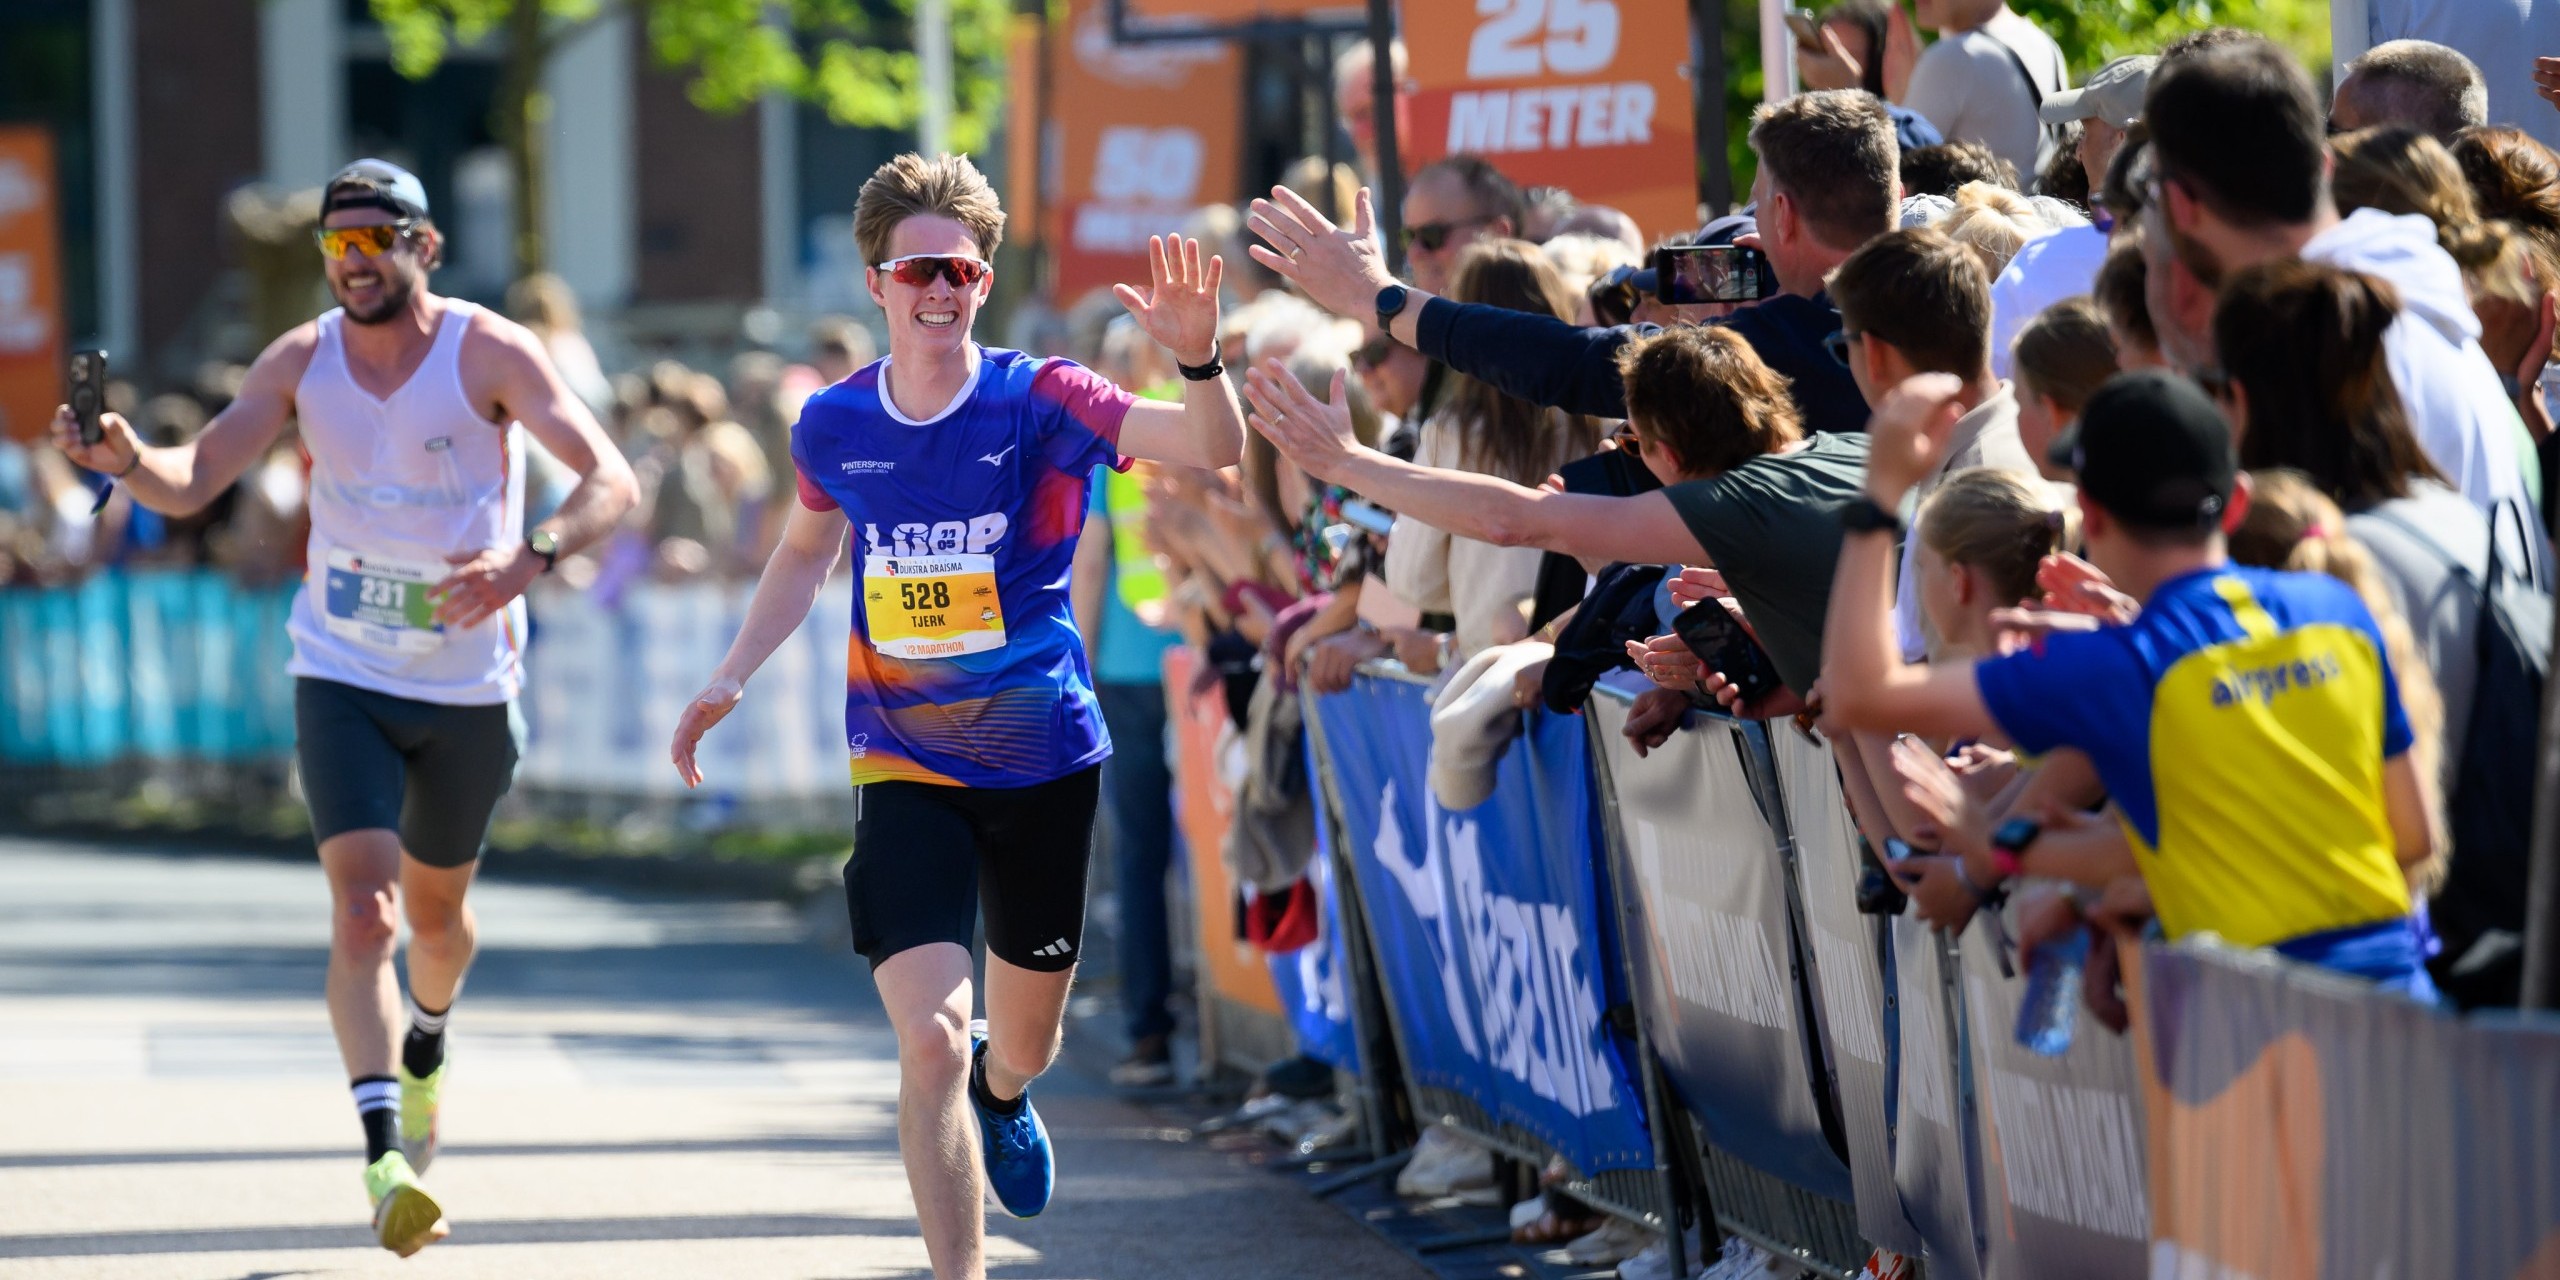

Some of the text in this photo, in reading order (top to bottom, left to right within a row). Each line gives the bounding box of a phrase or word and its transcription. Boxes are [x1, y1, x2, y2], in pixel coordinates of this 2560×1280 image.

[1467, 0, 1622, 79] 25
[1446, 80, 1657, 154] METER
[865, 511, 1009, 557] LOOP
[930, 562, 963, 573] DRAISMA
[360, 576, 406, 609] 231
[901, 581, 951, 610] 528
[911, 614, 946, 628] TJERK
[917, 640, 965, 656] MARATHON
